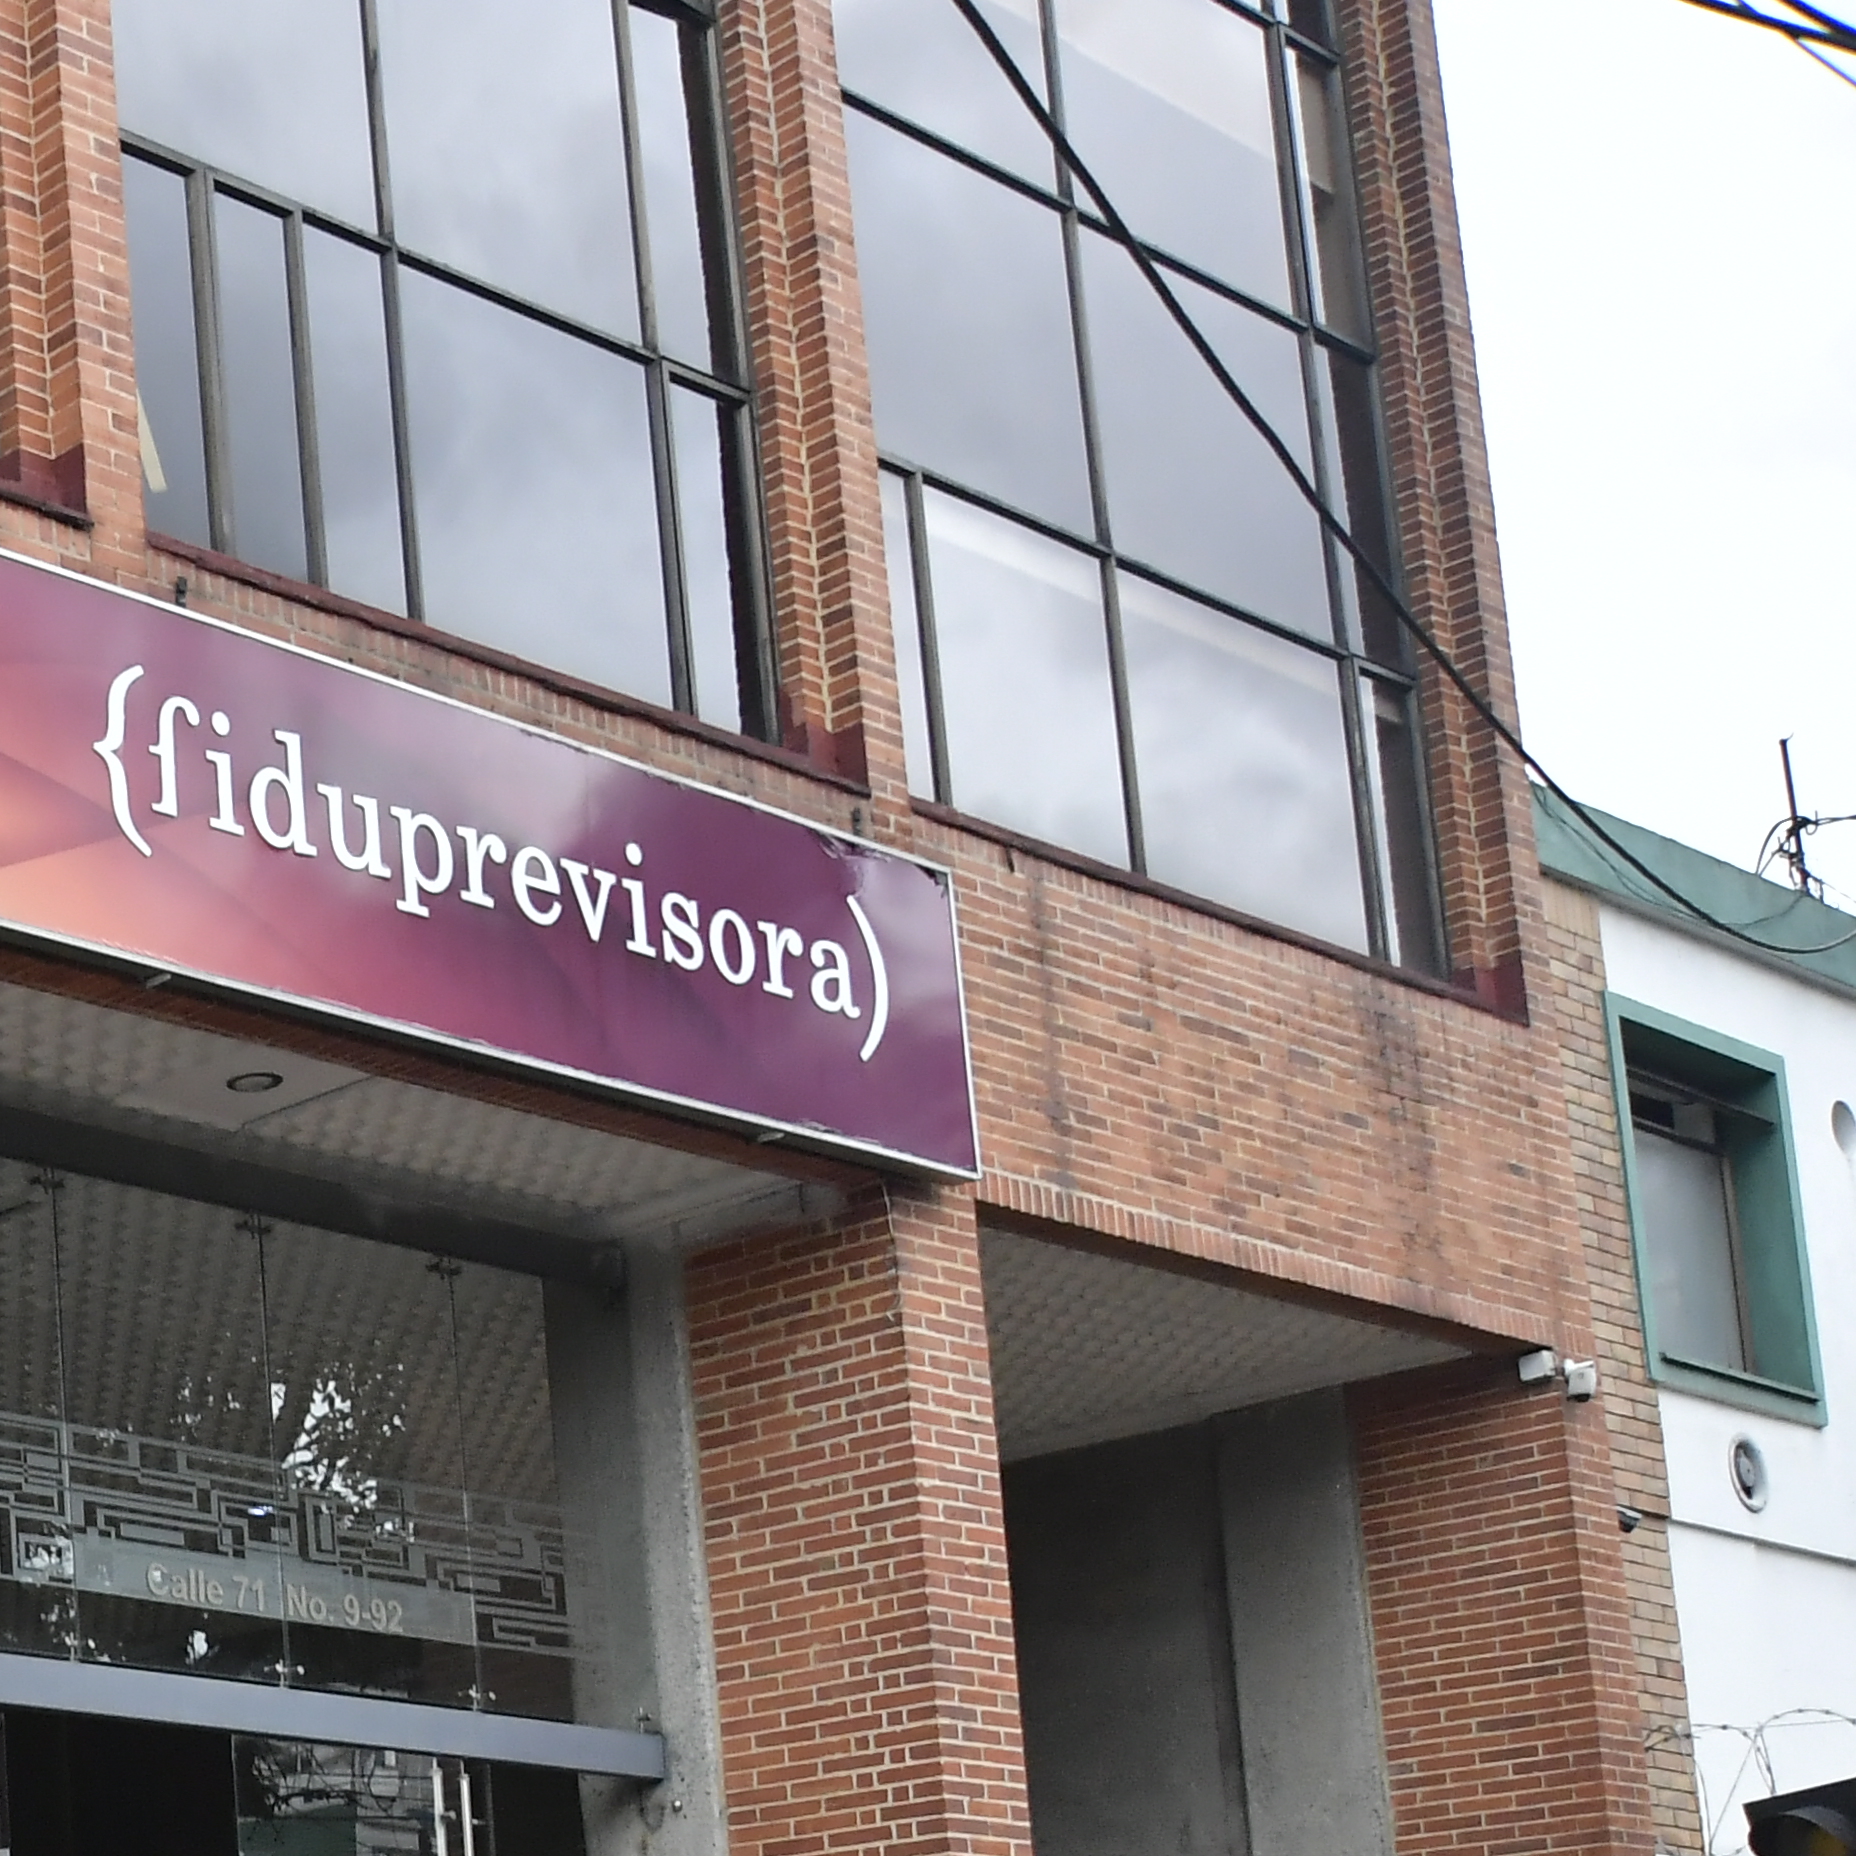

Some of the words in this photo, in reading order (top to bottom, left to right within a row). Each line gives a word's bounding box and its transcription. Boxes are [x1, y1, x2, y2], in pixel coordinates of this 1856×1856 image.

[146, 1562, 224, 1605] Calle
[232, 1575, 265, 1612] 71
[286, 1583, 334, 1624] No.
[341, 1593, 404, 1634] 9-92
